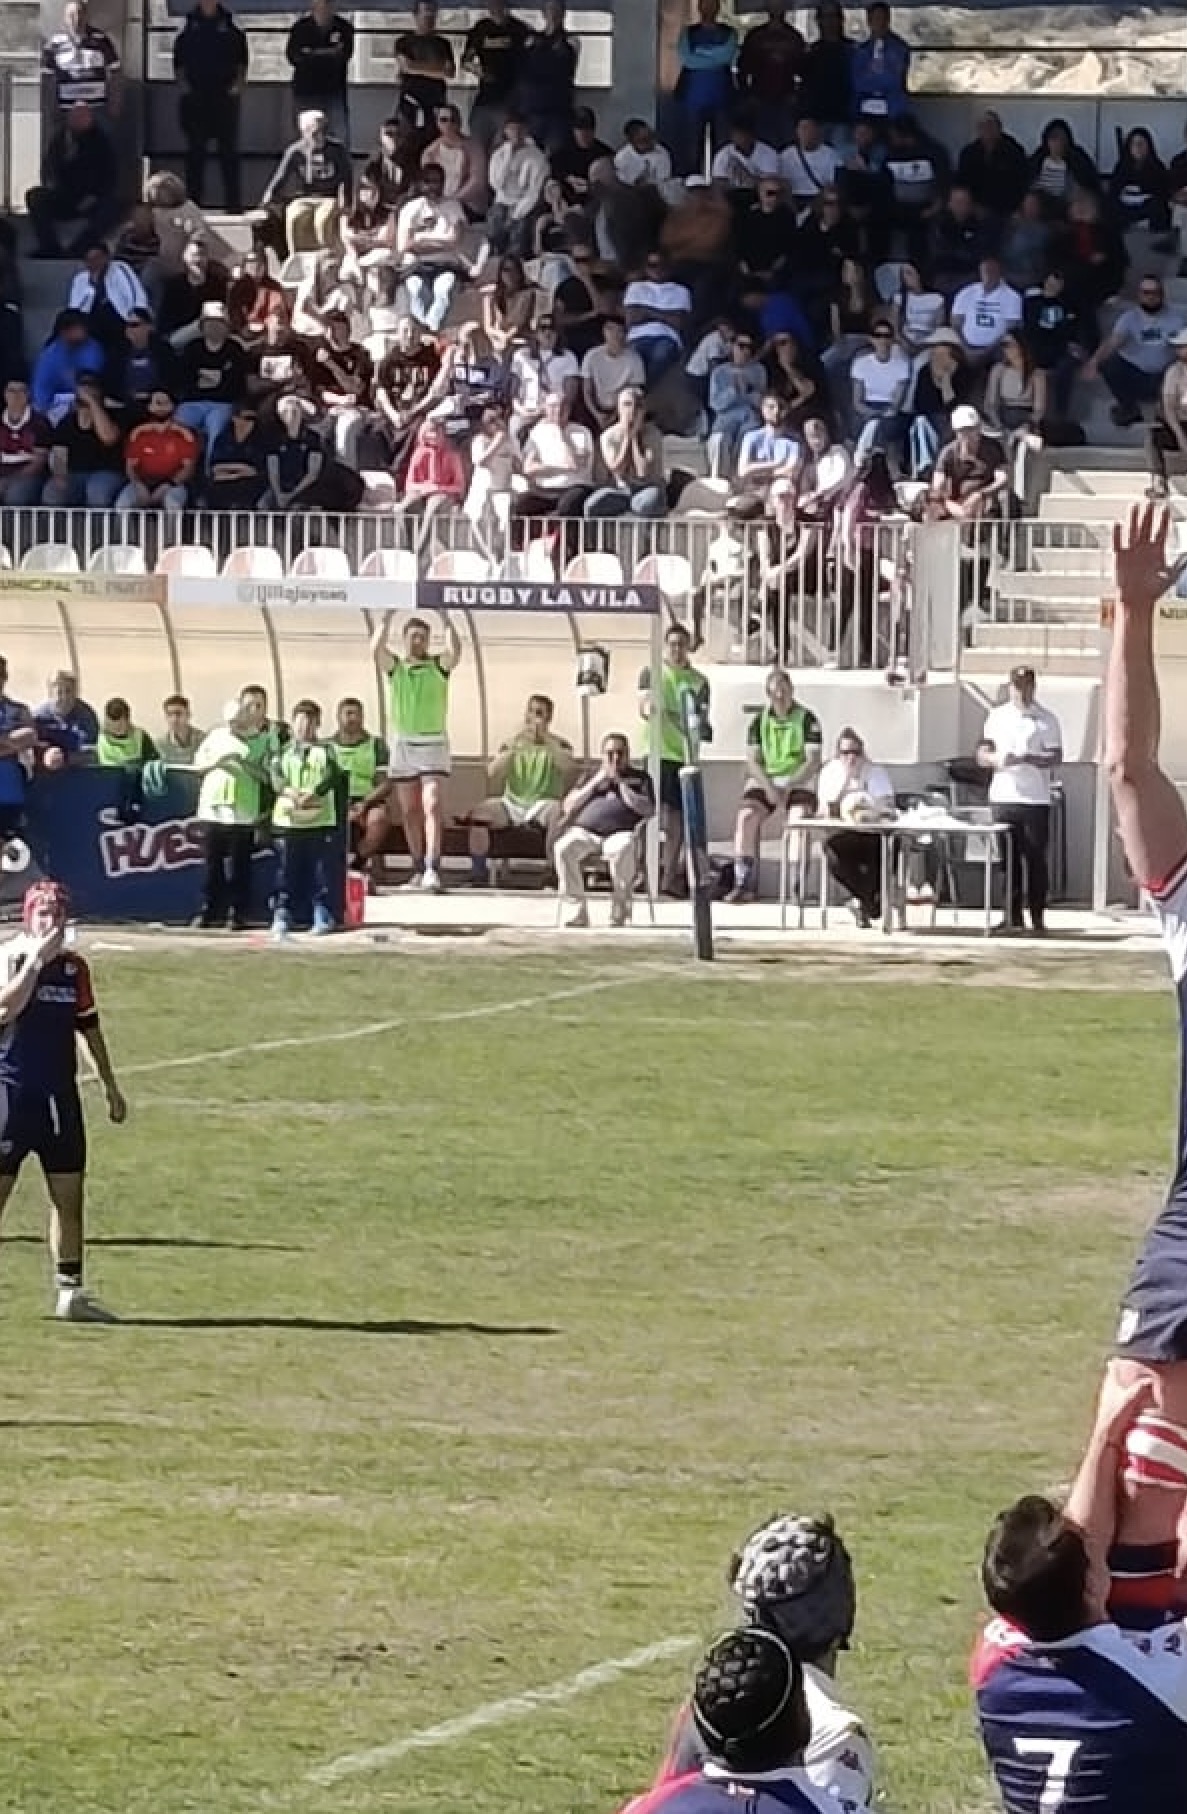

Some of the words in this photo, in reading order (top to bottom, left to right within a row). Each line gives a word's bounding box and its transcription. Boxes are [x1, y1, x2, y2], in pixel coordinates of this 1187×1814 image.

[443, 585, 533, 605] RUGBY
[540, 588, 573, 606] LA
[581, 588, 642, 607] VILA
[1013, 1738, 1082, 1814] 7
